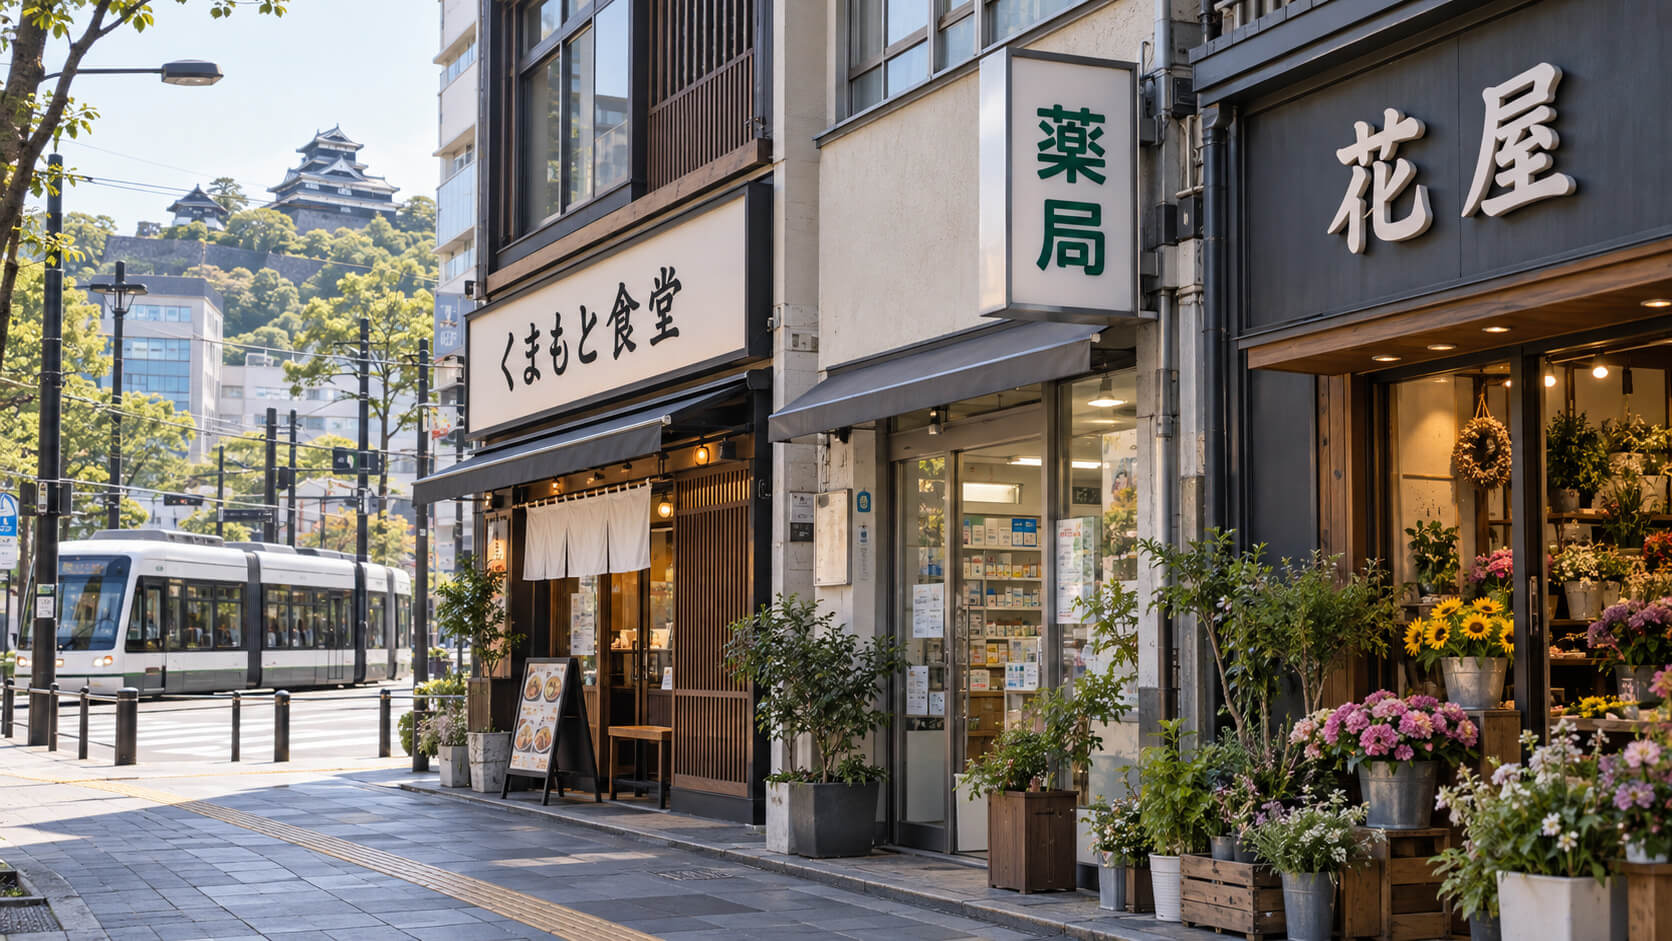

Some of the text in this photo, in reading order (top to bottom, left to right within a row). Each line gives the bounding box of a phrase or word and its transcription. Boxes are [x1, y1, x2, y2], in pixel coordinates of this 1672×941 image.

[1037, 104, 1106, 276] 薬局
[1327, 62, 1576, 254] 花屋
[501, 266, 682, 392] くまもと食堂
